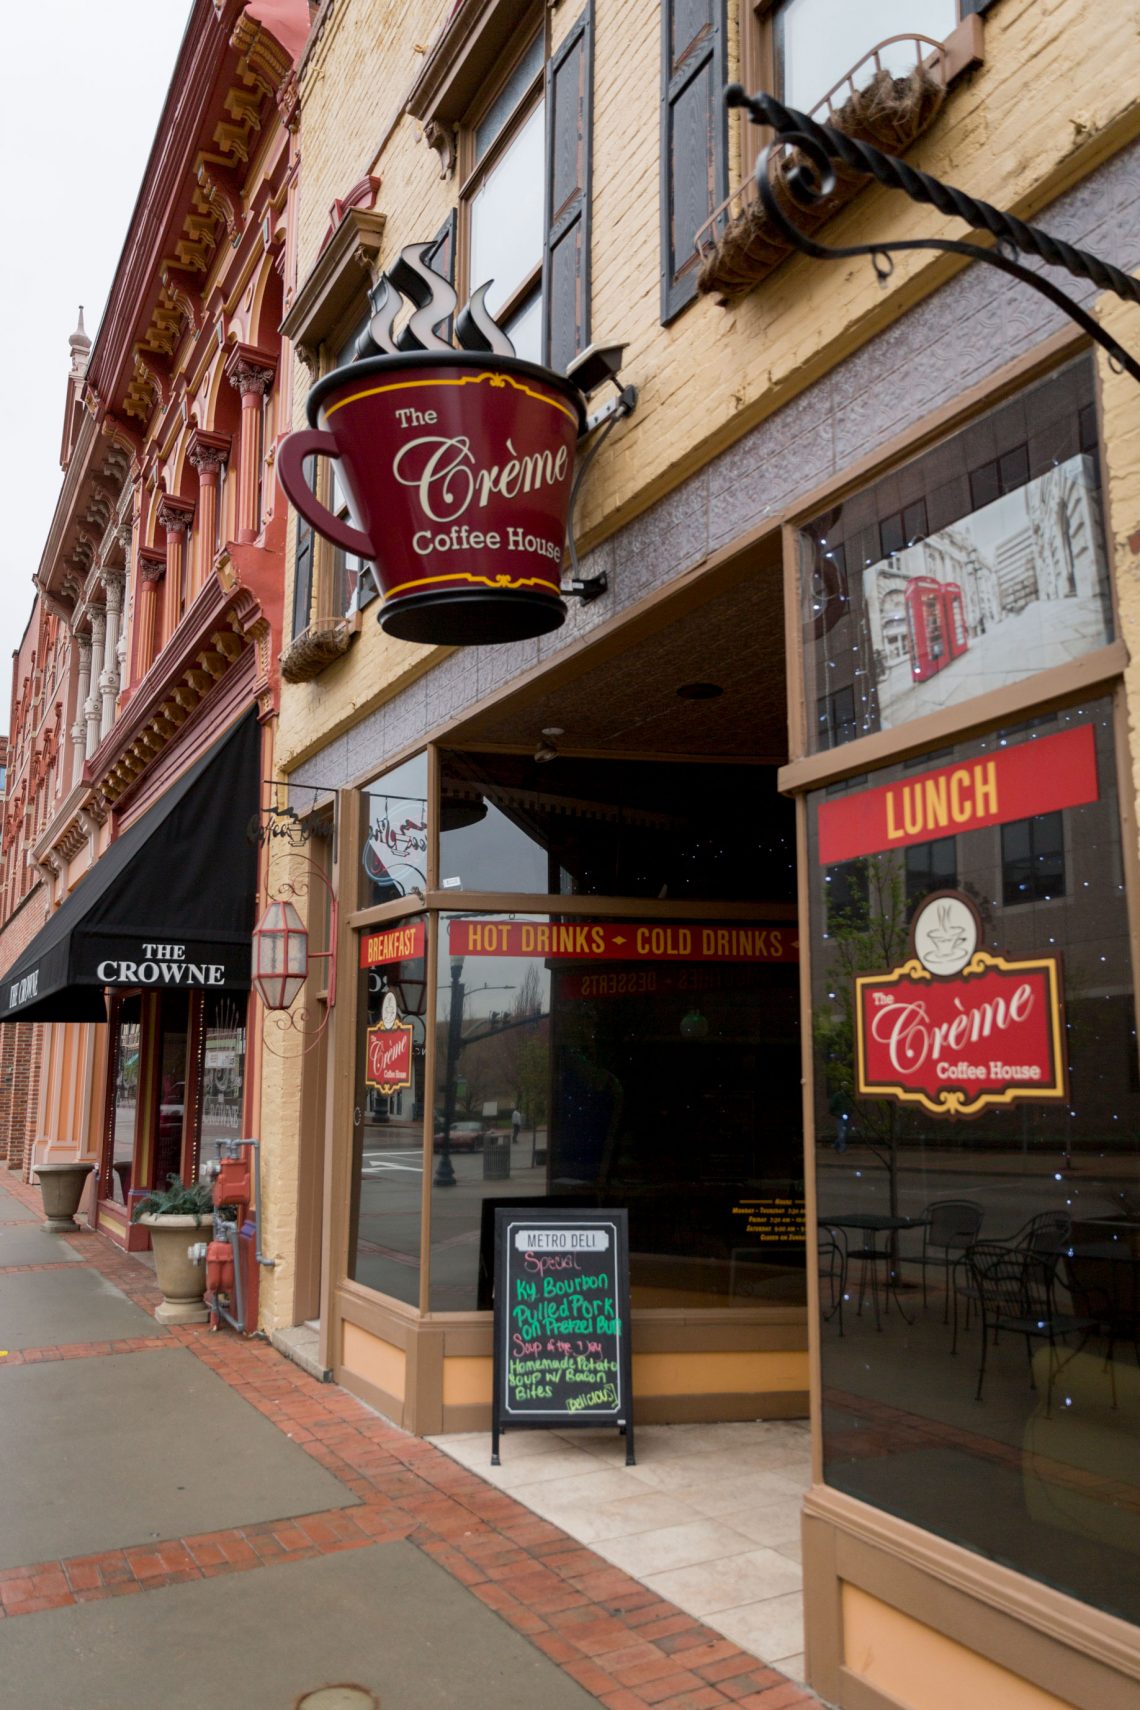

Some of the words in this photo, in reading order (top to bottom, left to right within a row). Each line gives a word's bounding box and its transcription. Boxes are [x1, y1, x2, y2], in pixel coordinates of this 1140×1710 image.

[395, 408, 438, 429] The
[393, 436, 568, 522] Crème
[412, 526, 501, 555] Coffee
[507, 528, 561, 563] House
[885, 761, 998, 840] LUNCH
[142, 943, 186, 960] THE
[367, 927, 416, 961] BREAKFAST
[468, 923, 511, 952] HOT
[521, 926, 605, 954] DRINKS
[636, 928, 692, 956] COLD
[702, 930, 783, 957] DRINKS
[96, 960, 226, 986] CROWNE
[872, 992, 894, 1006] The
[871, 983, 1035, 1075] Crème
[936, 1061, 987, 1080] Coffee
[989, 1061, 1041, 1080] House
[527, 1233, 566, 1249] METRO
[571, 1233, 595, 1249] DELI
[524, 1250, 582, 1277] Special
[543, 1273, 608, 1298] Bourbon
[512, 1298, 570, 1328] Pulled
[569, 1294, 615, 1318] Pork
[522, 1320, 541, 1340] on
[542, 1316, 593, 1335] Pretzel
[597, 1315, 622, 1336] Bun
[512, 1333, 542, 1358] Soup
[573, 1340, 604, 1361] Day
[509, 1355, 576, 1374] Homemade
[576, 1355, 618, 1371] Potato
[565, 1368, 607, 1383] Bacon
[515, 1384, 553, 1401] Bites
